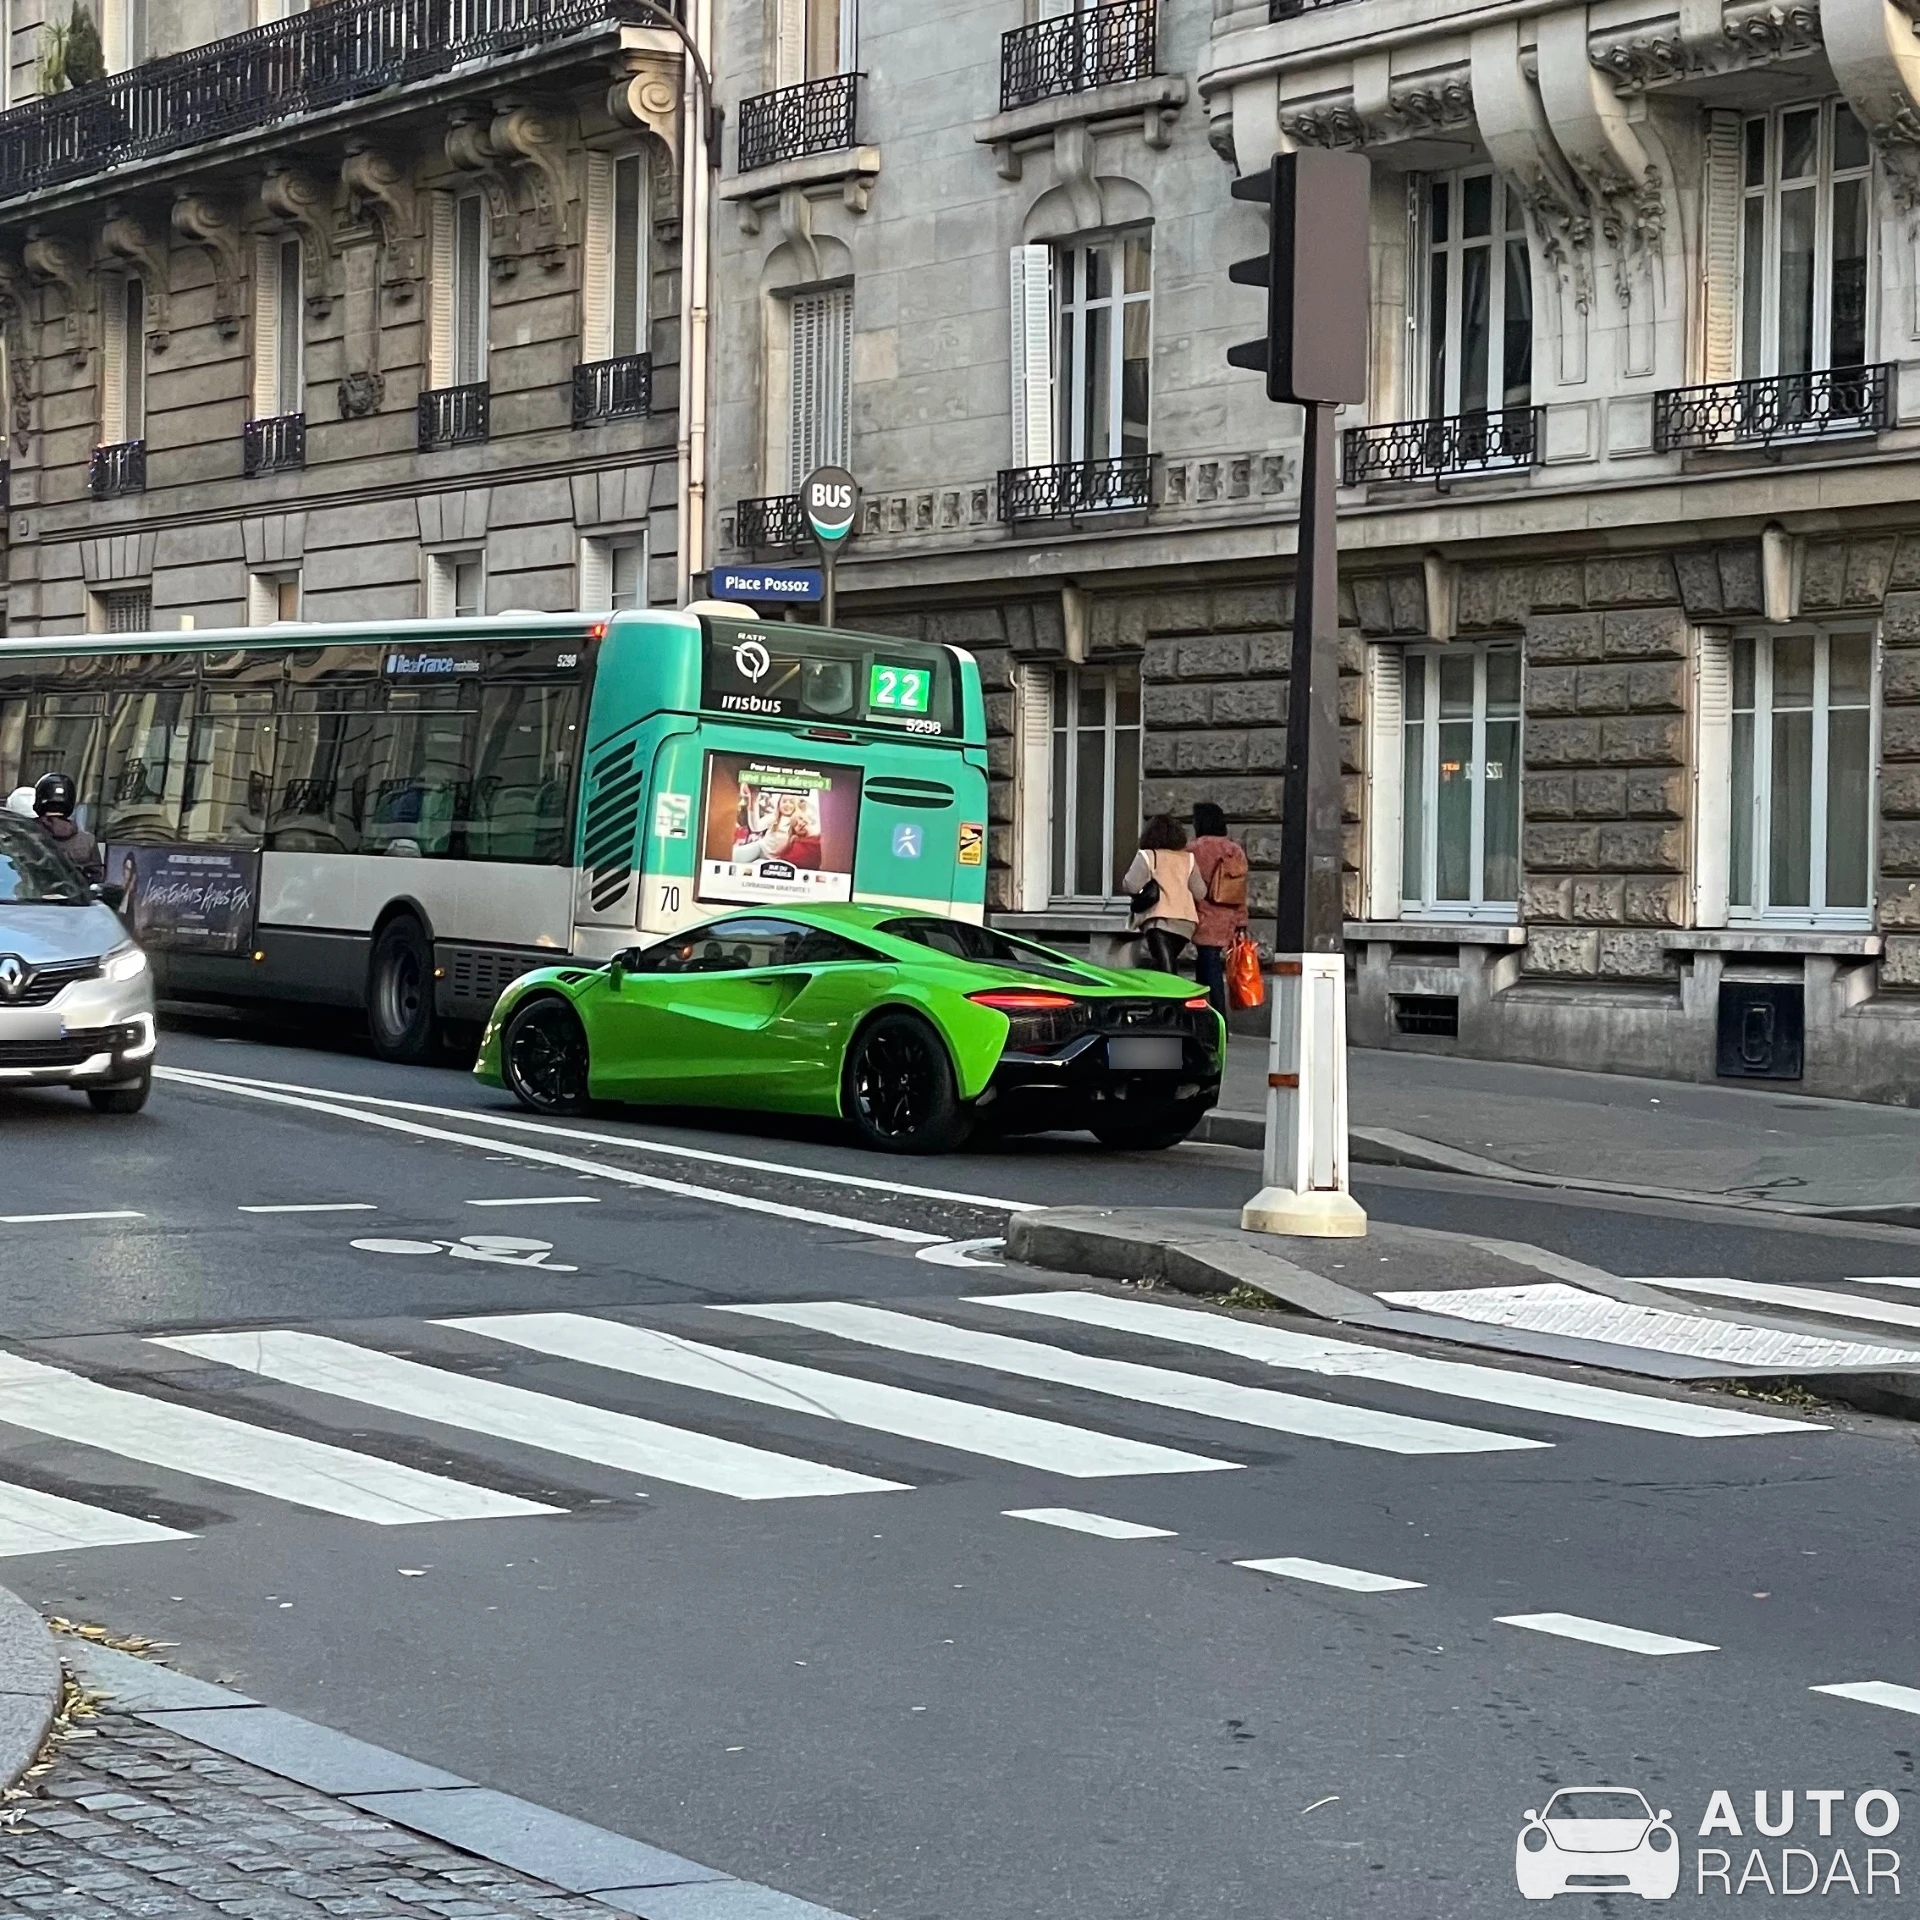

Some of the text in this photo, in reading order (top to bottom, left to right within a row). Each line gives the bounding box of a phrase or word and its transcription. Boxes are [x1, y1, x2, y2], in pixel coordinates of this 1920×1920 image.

[811, 483, 852, 508] BUS
[725, 576, 810, 592] Place Possoz
[737, 632, 767, 642] RATP
[876, 670, 921, 707] 22
[905, 718, 942, 735] 5298
[660, 885, 680, 912] 70
